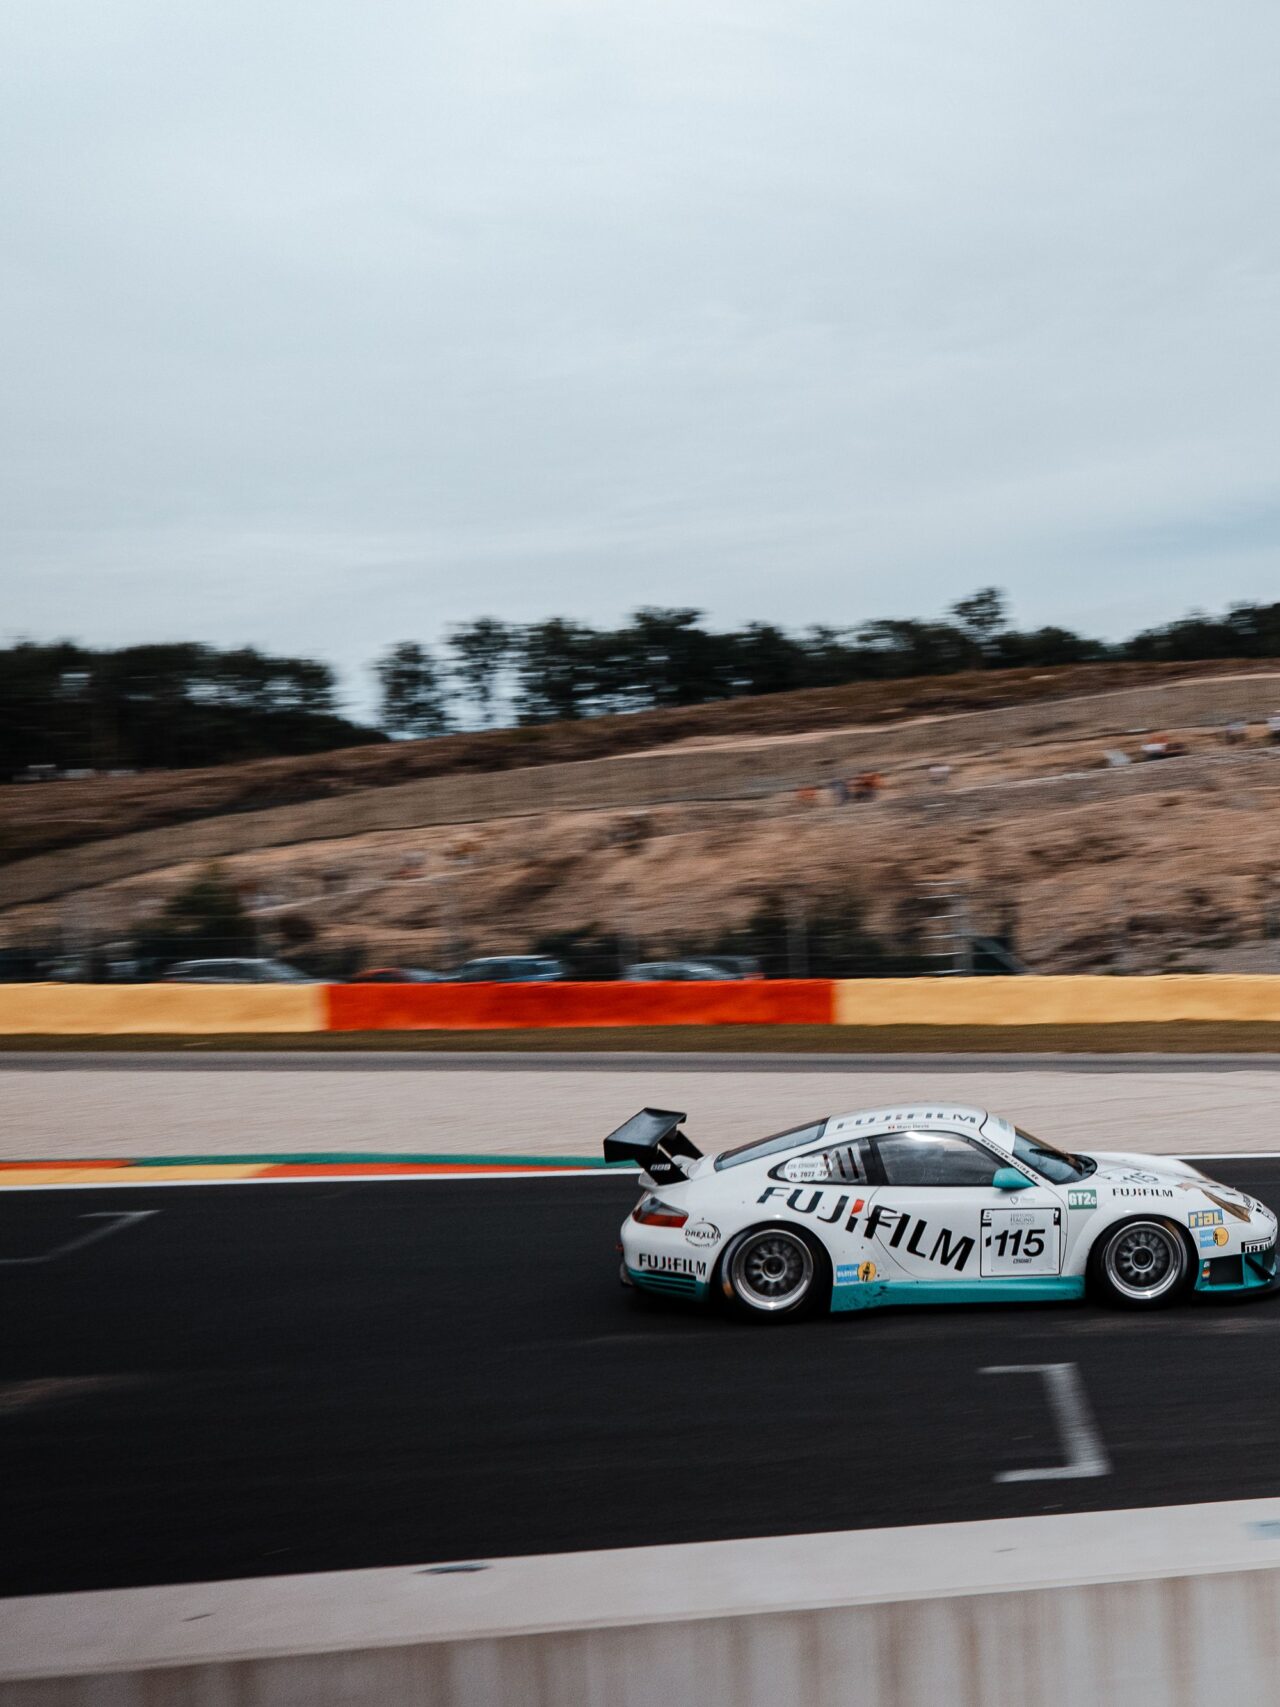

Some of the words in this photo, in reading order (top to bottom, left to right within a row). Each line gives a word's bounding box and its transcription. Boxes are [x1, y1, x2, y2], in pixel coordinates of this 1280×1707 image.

[1069, 1192, 1097, 1206] GT2c
[1112, 1188, 1174, 1198] FUJIFILM
[684, 1229, 721, 1240] DREXLER
[756, 1186, 976, 1272] FUJIFILM
[995, 1228, 1046, 1258] 115
[638, 1252, 707, 1277] FUJIFILM
